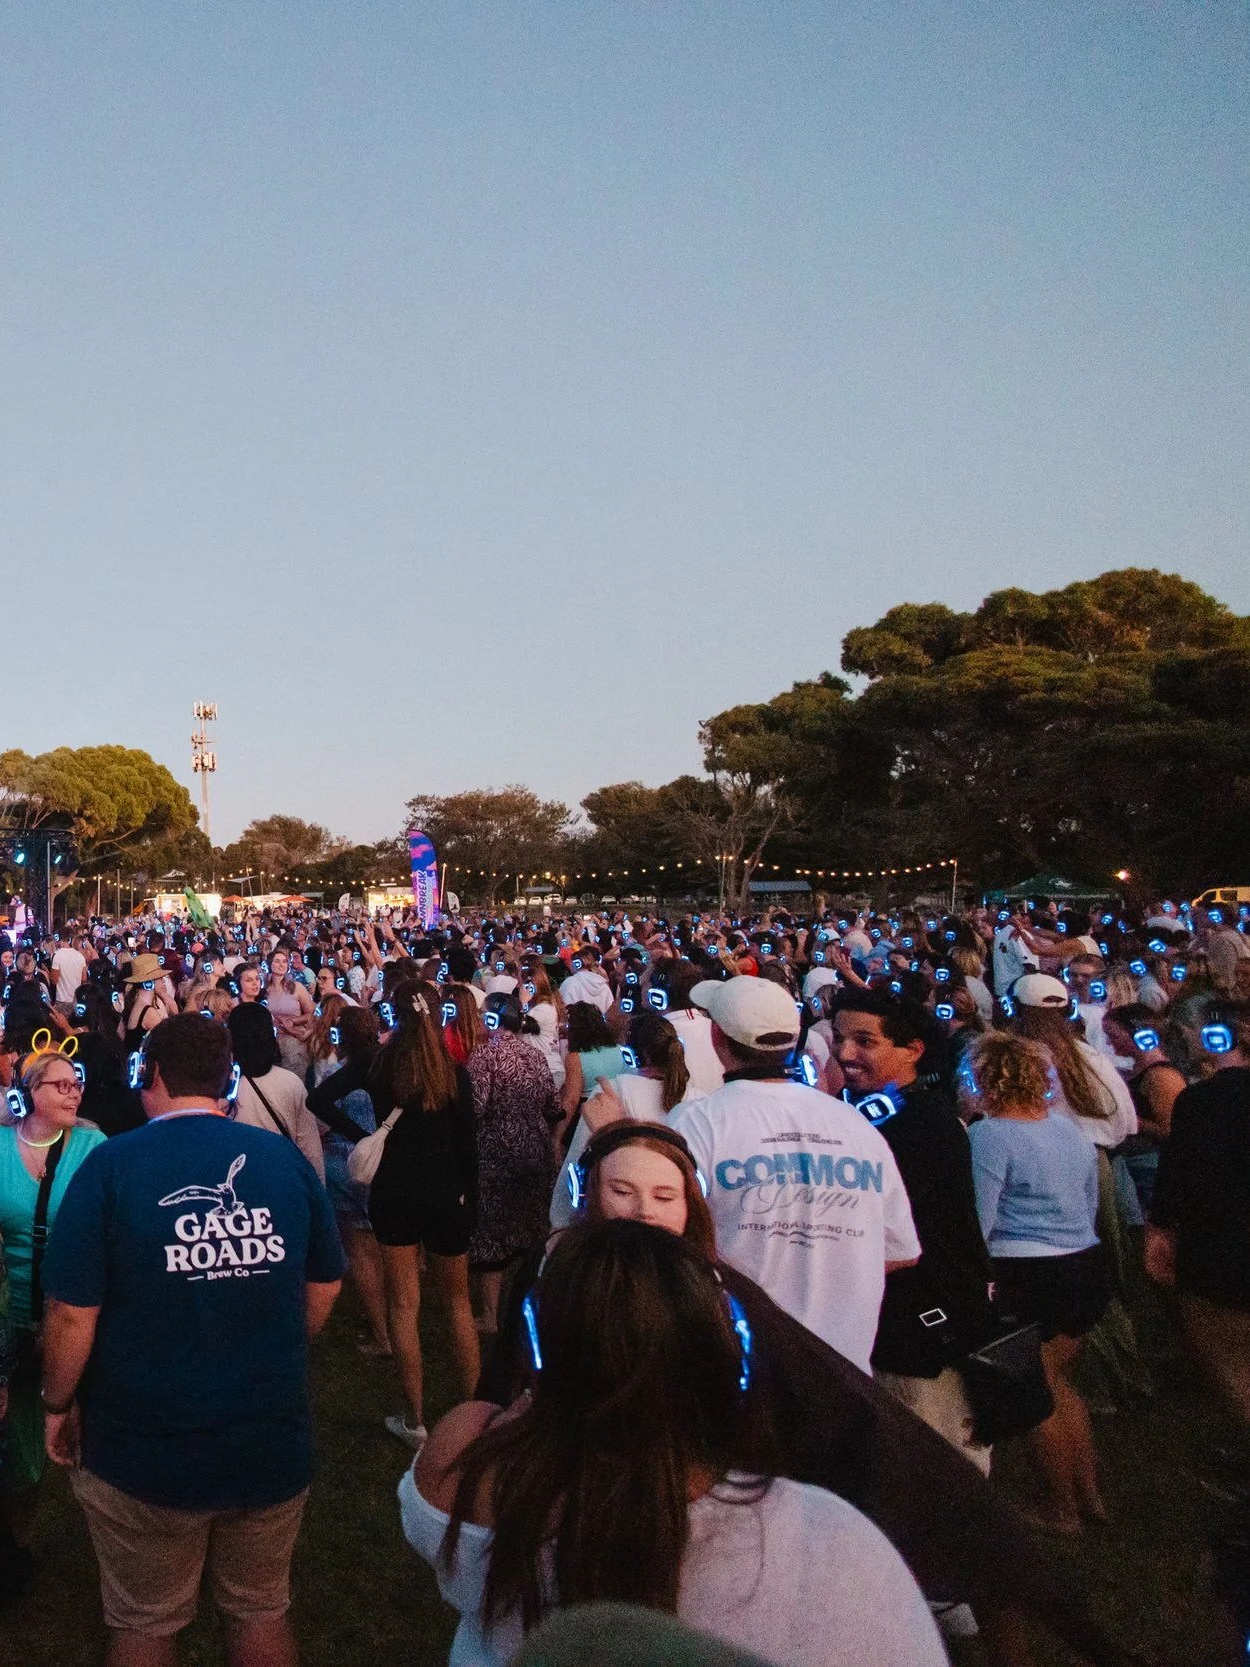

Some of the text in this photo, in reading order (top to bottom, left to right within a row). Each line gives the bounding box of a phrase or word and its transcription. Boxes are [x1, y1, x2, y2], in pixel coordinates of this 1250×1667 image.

[715, 1152, 883, 1193] COMMON
[174, 1207, 273, 1242] GAGE
[164, 1235, 286, 1272] ROADS
[207, 1267, 250, 1280] Brew Co
